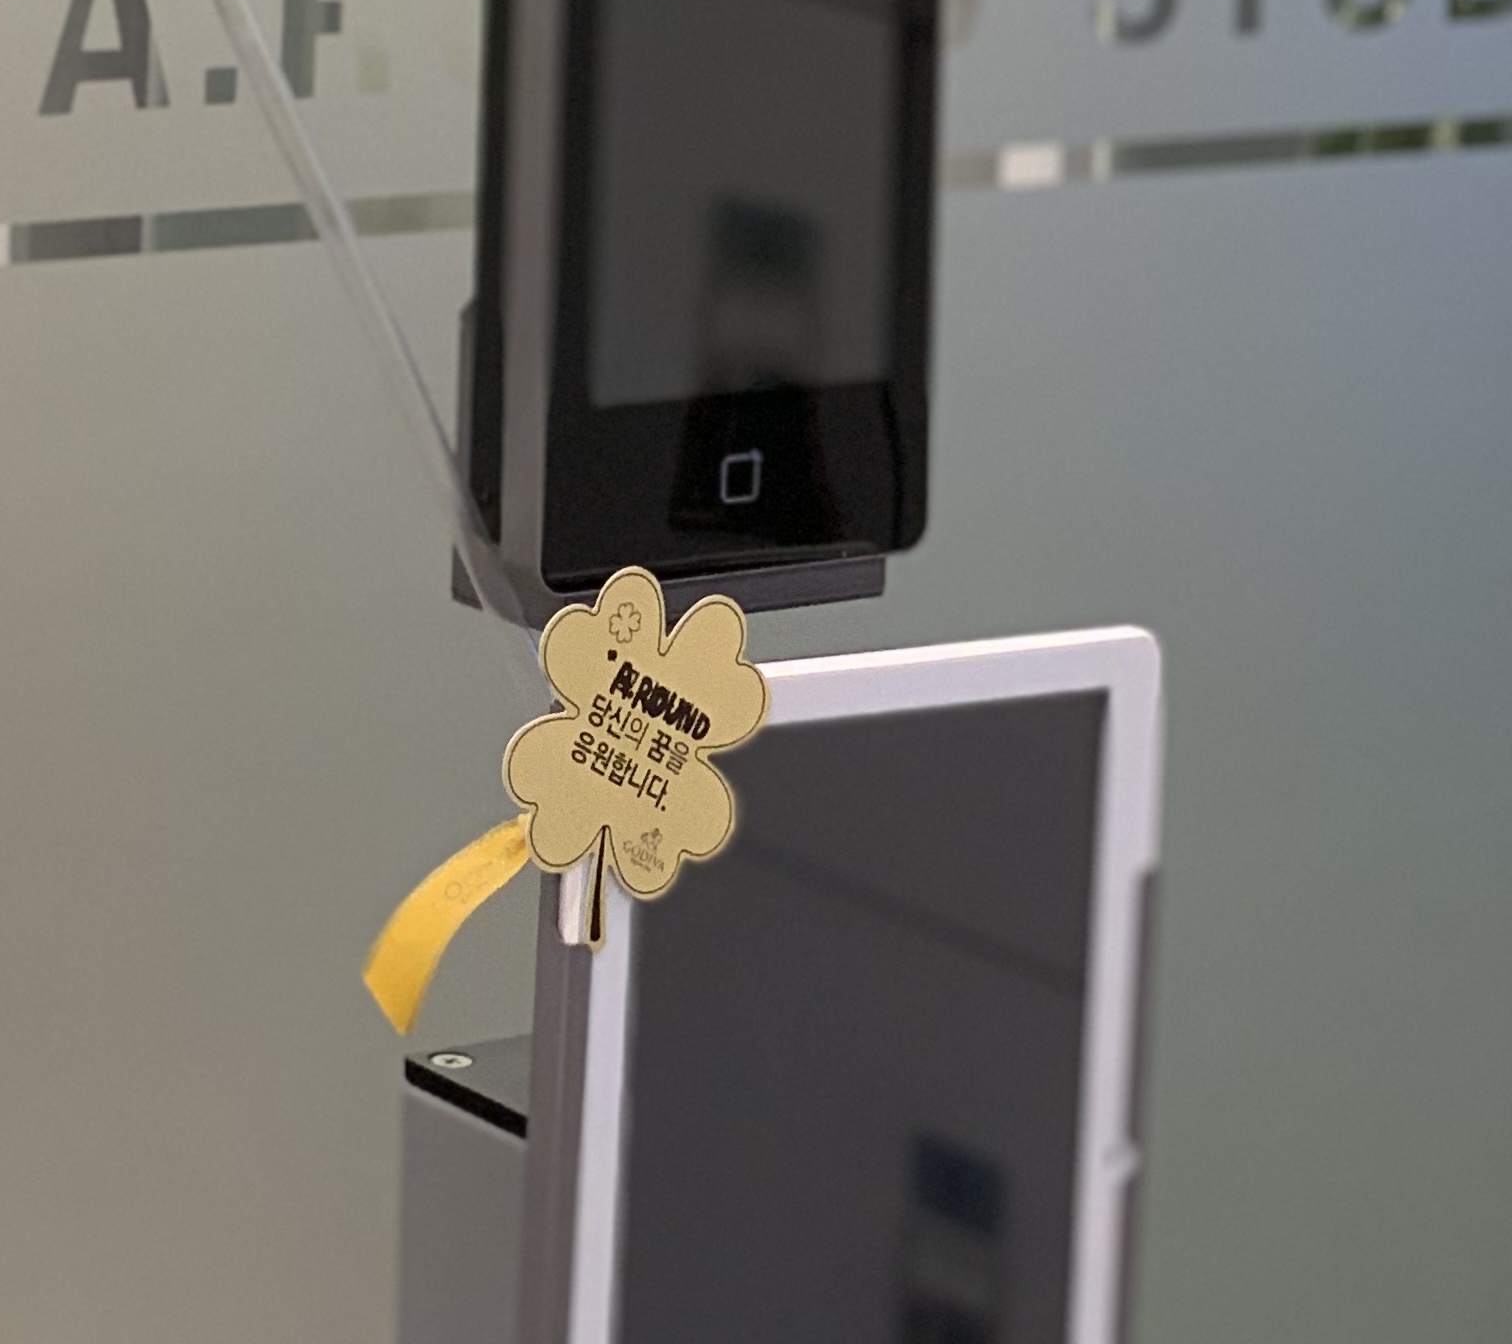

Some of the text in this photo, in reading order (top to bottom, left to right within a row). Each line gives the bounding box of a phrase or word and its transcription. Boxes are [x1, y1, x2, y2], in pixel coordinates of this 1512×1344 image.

[570, 730, 670, 812] 응원합니다.
[587, 693, 690, 776] 당신의 꿈을
